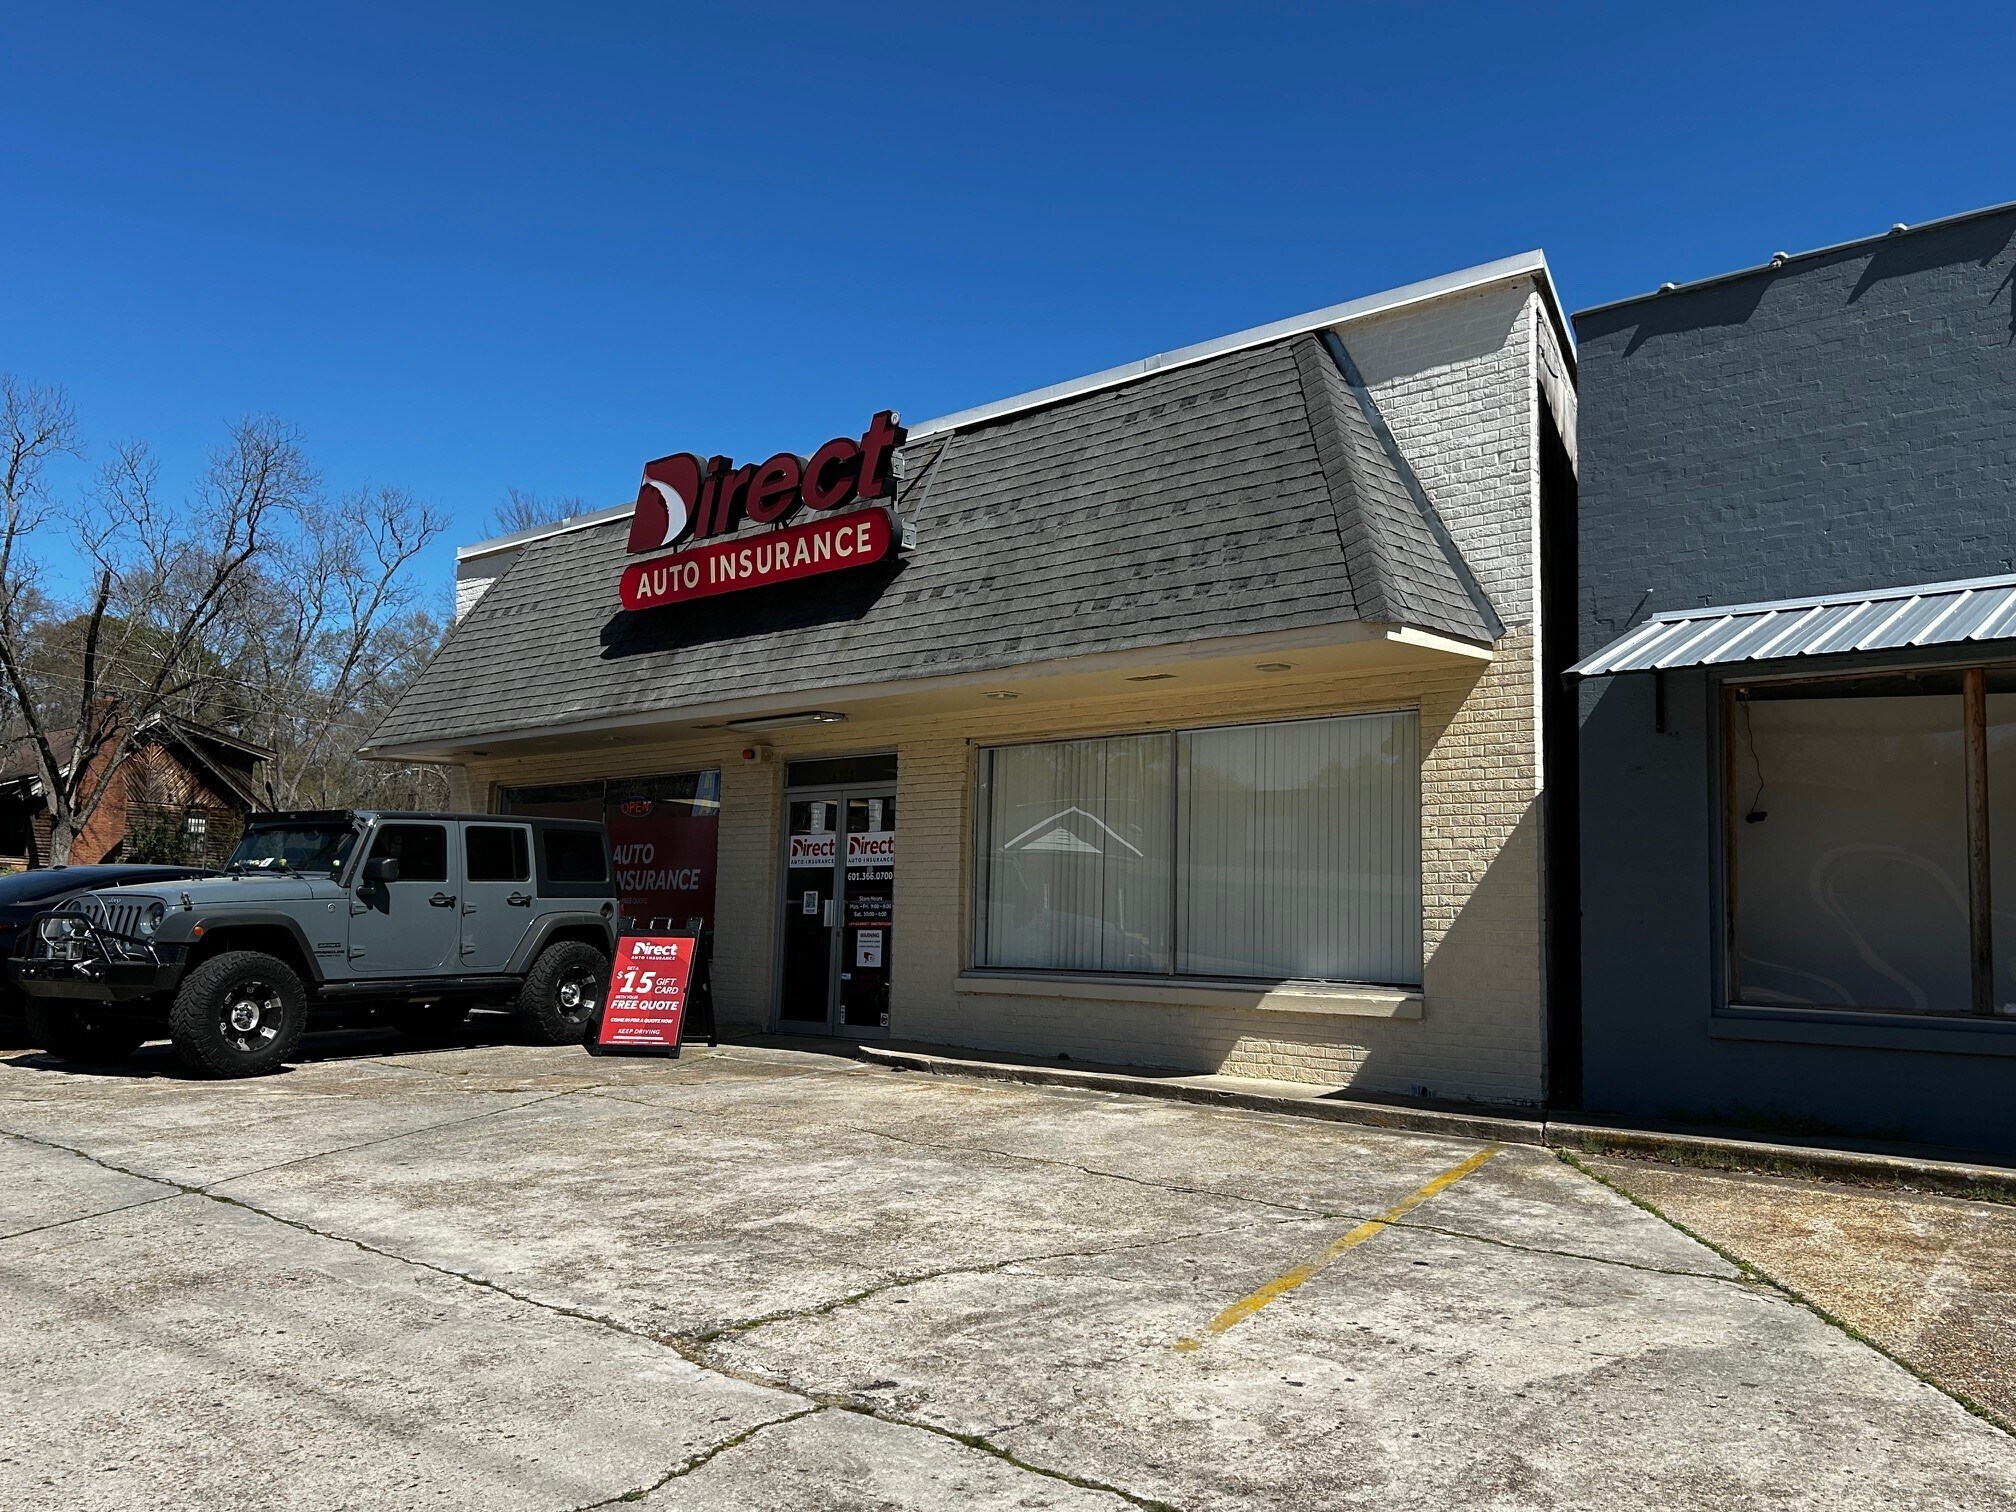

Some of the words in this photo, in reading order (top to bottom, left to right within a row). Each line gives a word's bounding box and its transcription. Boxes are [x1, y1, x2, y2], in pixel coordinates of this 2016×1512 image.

[626, 409, 897, 553] Direct
[636, 561, 700, 600] AUTO
[709, 522, 873, 584] INSURANCE
[621, 800, 652, 814] OPEN
[613, 843, 655, 865] AUTO
[791, 838, 835, 857] Direct
[849, 835, 894, 855] Direct
[617, 868, 701, 891] NSURANCE
[847, 871, 893, 881] 601.366.0700
[632, 942, 678, 956] Direct
[616, 970, 657, 994] $15
[654, 986, 679, 995] CARD
[656, 978, 677, 986] GIFT
[610, 1000, 639, 1010] FREE
[639, 1000, 679, 1011] QUOTE
